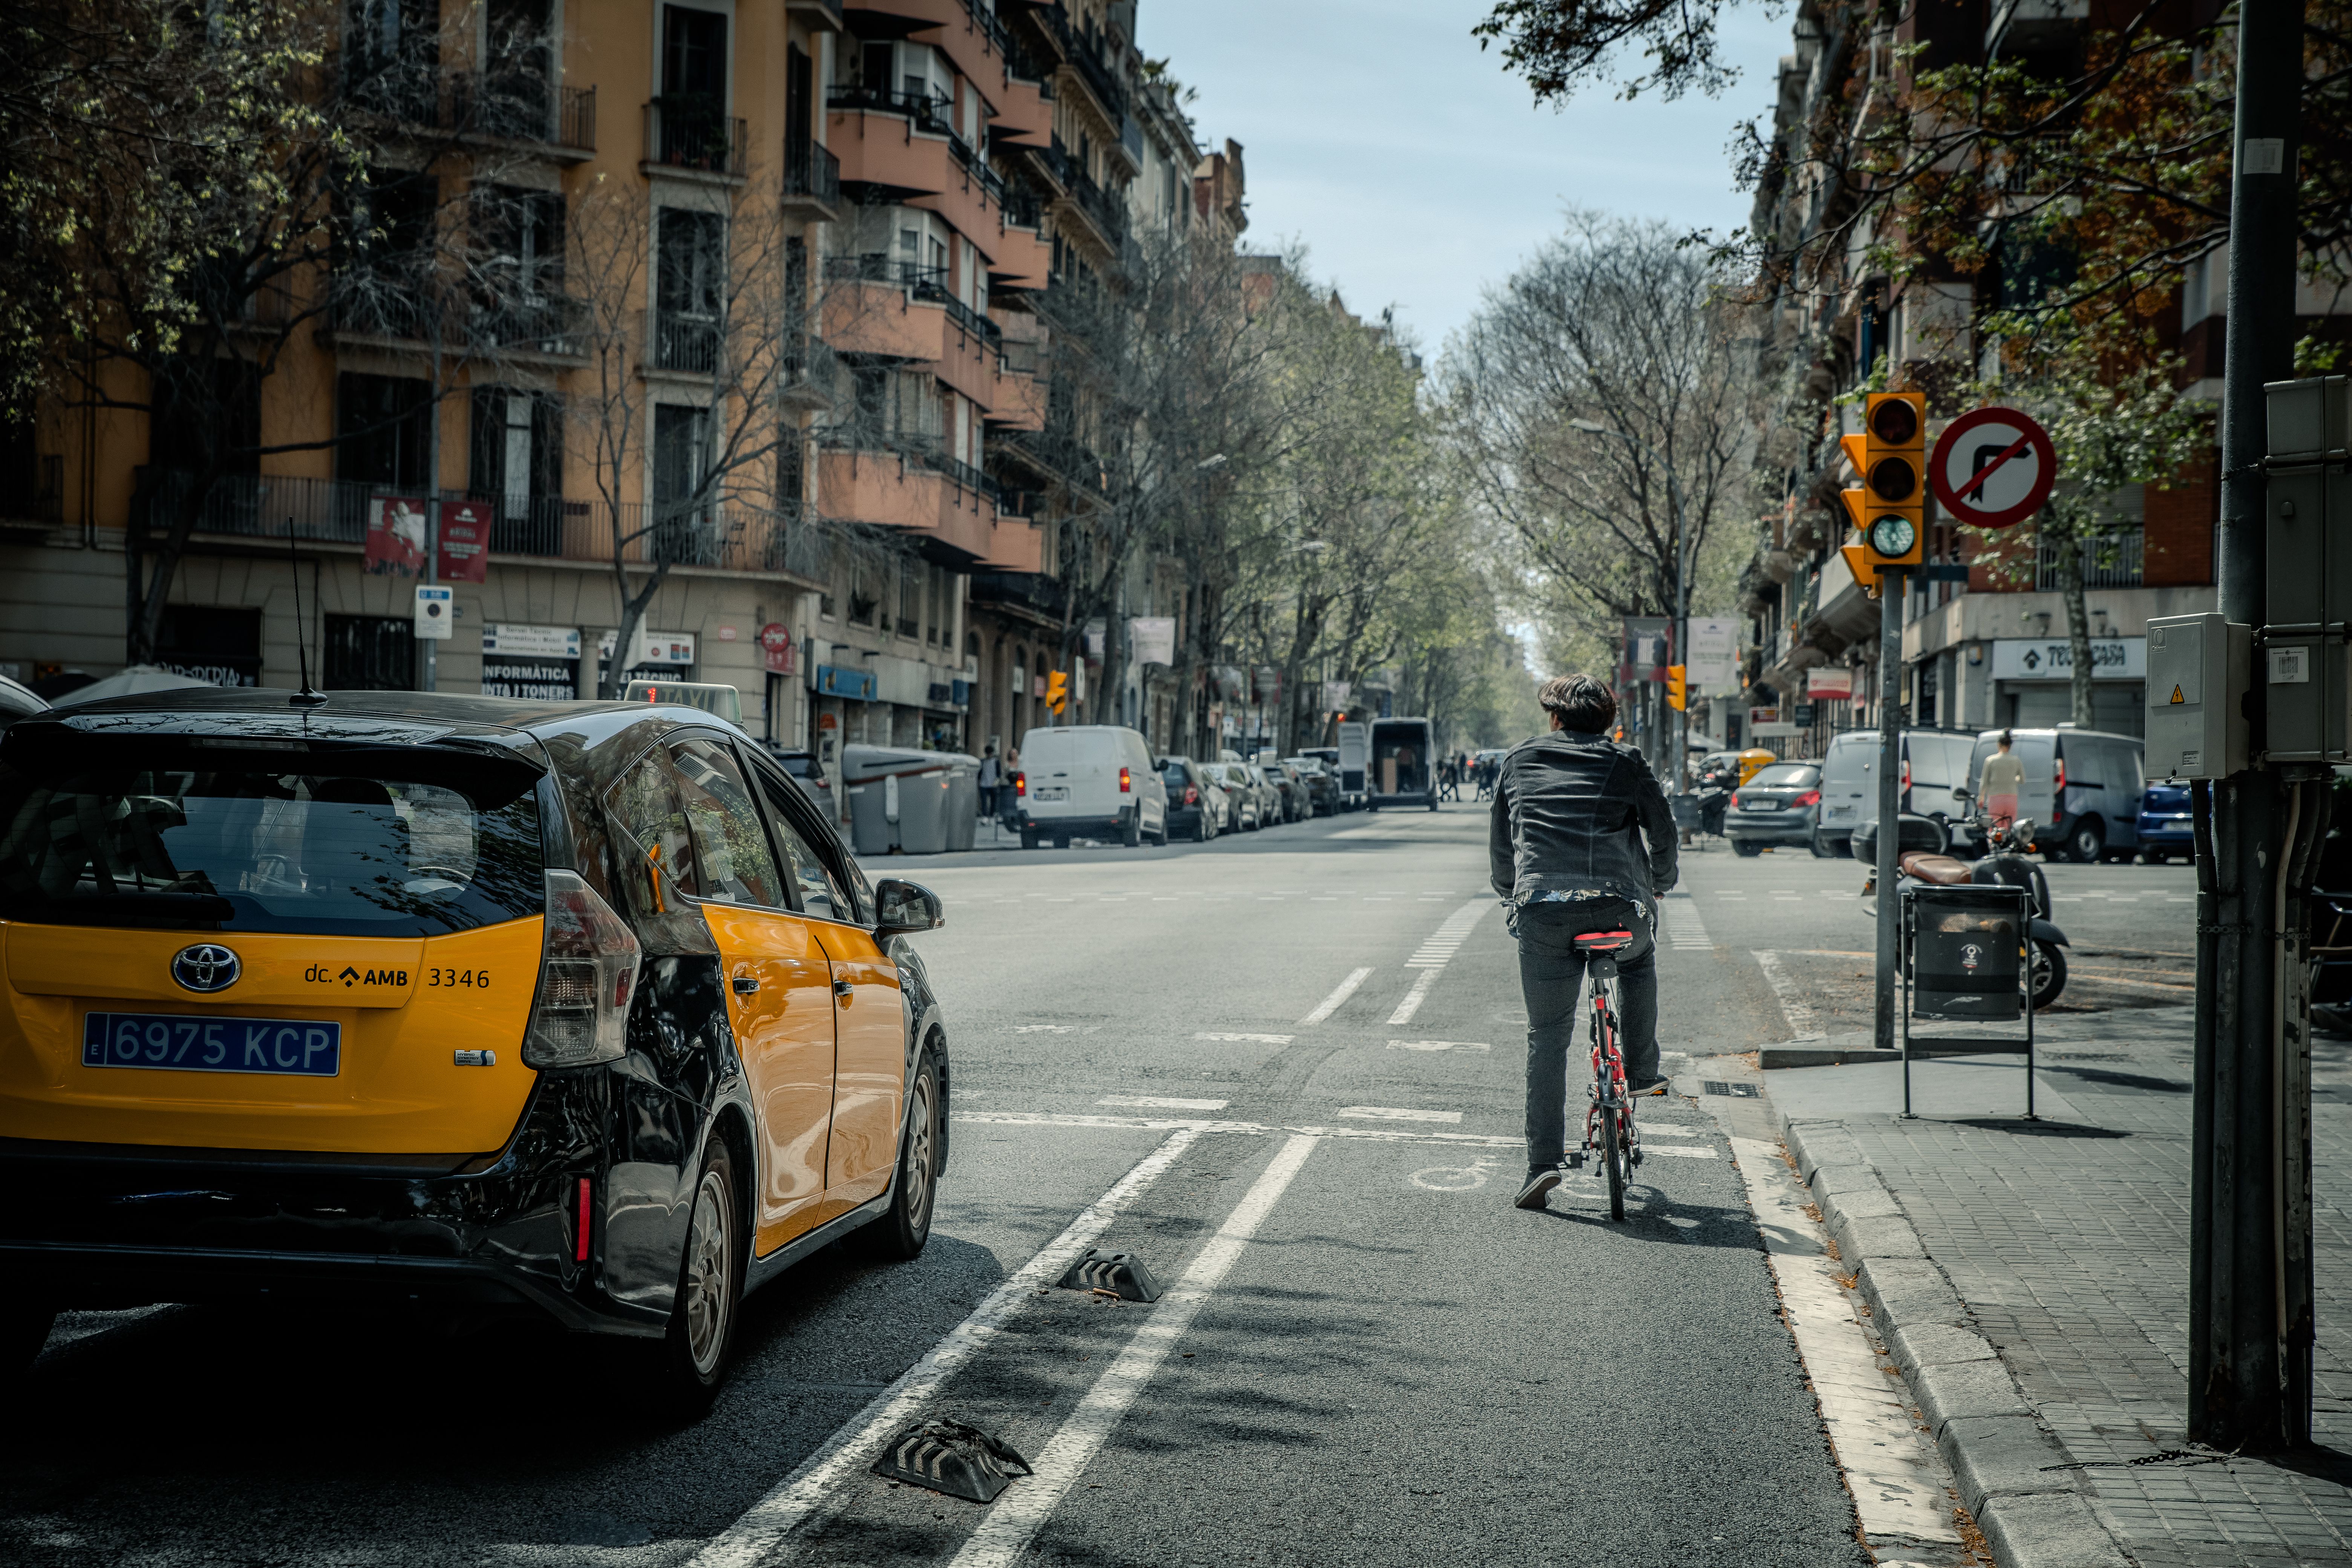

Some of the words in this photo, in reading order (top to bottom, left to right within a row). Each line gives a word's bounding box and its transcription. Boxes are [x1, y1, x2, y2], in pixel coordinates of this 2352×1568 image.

[2047, 644, 2126, 666] TECCASA
[521, 684, 574, 700] TONERS
[648, 687, 657, 704] 1
[662, 688, 710, 711] TAXI
[304, 963, 332, 983] dc.
[363, 969, 408, 986] AMB
[428, 968, 490, 988] 3346
[91, 1044, 99, 1055] E
[116, 1020, 226, 1064] 6975
[244, 1026, 329, 1068] KCP
